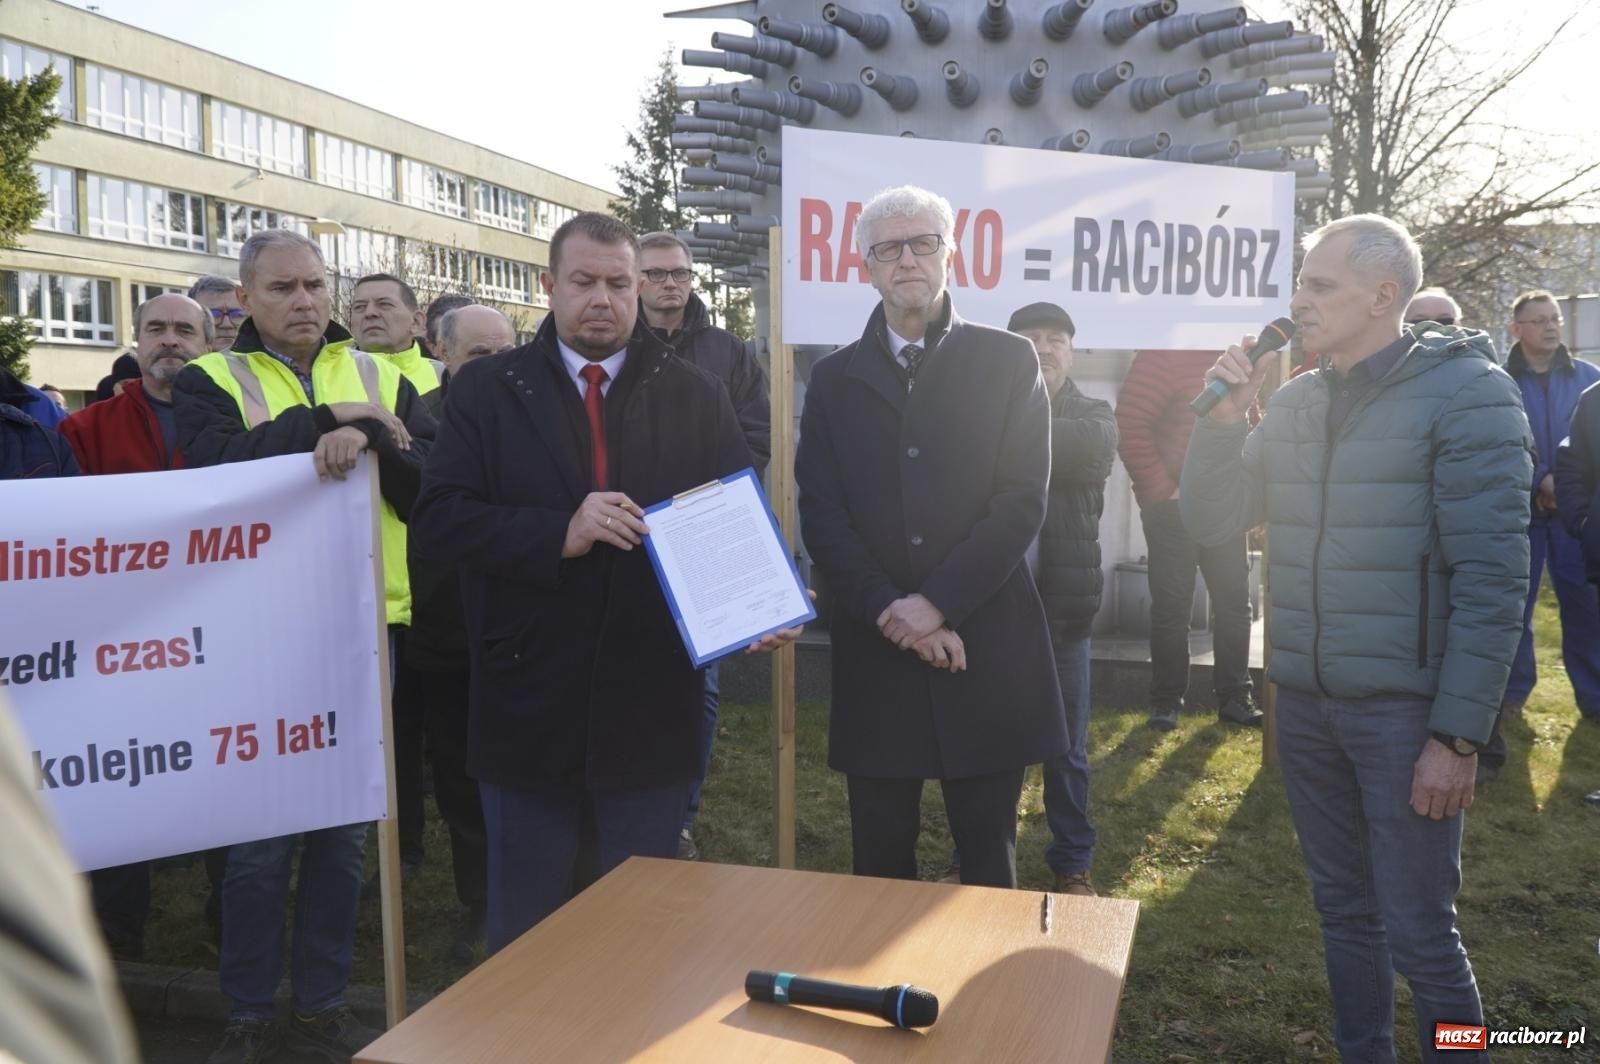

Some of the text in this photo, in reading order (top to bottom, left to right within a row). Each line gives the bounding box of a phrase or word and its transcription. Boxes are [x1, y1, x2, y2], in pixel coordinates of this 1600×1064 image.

[800, 198, 1003, 290] RAKO
[1072, 205, 1280, 298] RACIBÓRZ
[0, 522, 272, 582] inistrze MAP
[95, 626, 206, 675] czas!
[32, 711, 337, 790] kolejne 75 lat!
